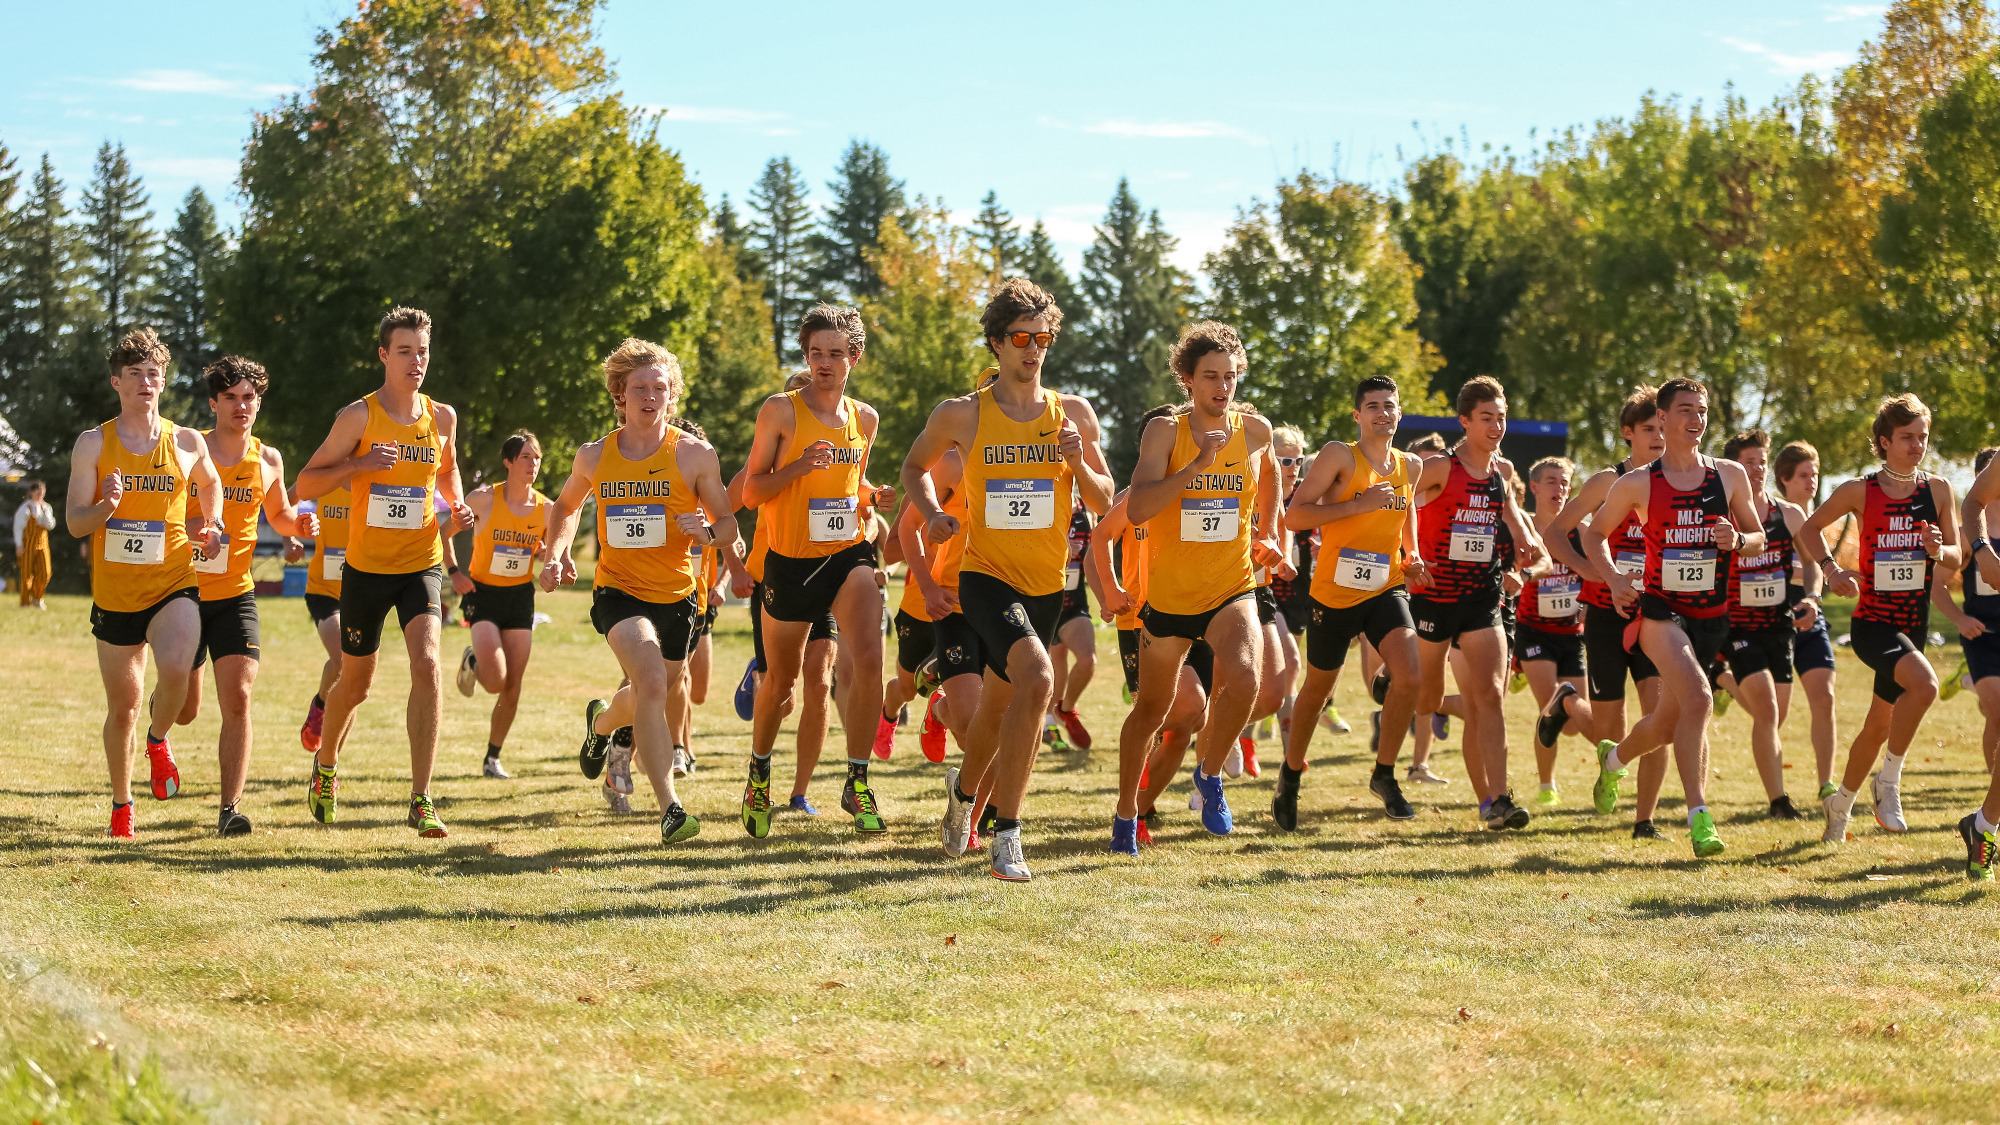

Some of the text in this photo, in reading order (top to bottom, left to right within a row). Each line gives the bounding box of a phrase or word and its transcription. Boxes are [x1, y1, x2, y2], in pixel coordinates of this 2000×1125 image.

[600, 480, 671, 499] GUSTAVUS
[1469, 494, 1490, 508] MLC
[387, 503, 407, 519] 38
[1008, 500, 1031, 517] 32
[827, 516, 844, 530] 40
[1454, 508, 1497, 524] KNIGHTS
[1677, 509, 1704, 525] MLC
[626, 523, 645, 537] 36
[1202, 517, 1220, 531] 37
[1889, 516, 1914, 531] MLC
[124, 538, 143, 553] 42
[1464, 540, 1485, 553] 135
[505, 559, 519, 570] 35
[1737, 550, 1781, 568] KNIGHTS
[1353, 566, 1371, 581] 34
[1677, 567, 1704, 581] 123
[1889, 567, 1913, 581] 133
[1753, 586, 1775, 598] 116
[1551, 598, 1571, 609] 118
[1419, 620, 1435, 632] MLC
[1526, 645, 1541, 658] MLC
